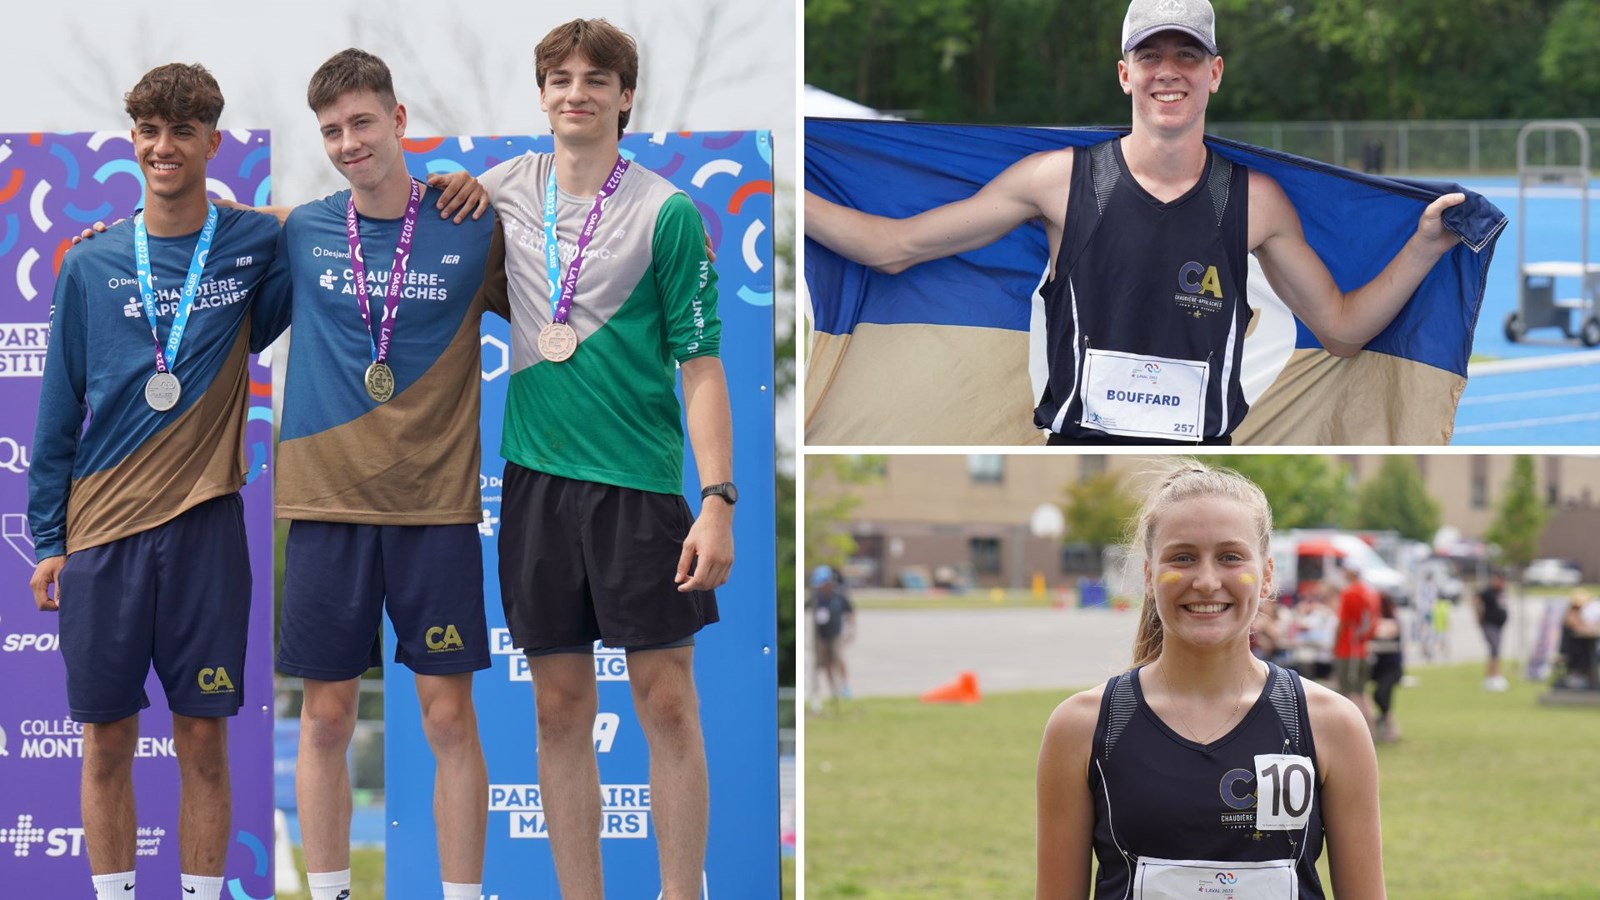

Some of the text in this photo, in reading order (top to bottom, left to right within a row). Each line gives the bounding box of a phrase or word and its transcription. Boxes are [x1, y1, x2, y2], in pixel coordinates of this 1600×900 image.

[607, 165, 625, 189] 2022
[201, 213, 217, 242] LAVAL
[401, 218, 415, 244] 2022
[584, 213, 598, 237] OASIS
[137, 240, 149, 265] 2022
[236, 256, 253, 268] IGA
[441, 254, 461, 265] IGA
[185, 272, 199, 297] OASIS
[356, 271, 366, 296] OASIS
[390, 272, 401, 297] OASIS
[561, 266, 579, 301] LAVAL
[1178, 261, 1223, 299] CA
[167, 324, 183, 352] 2022
[378, 327, 391, 361] LAVAL
[1106, 389, 1181, 407] BOUFFARD
[1173, 423, 1195, 433] 257
[425, 624, 464, 650] CA
[198, 666, 234, 691] CA
[1219, 768, 1258, 810] C
[1261, 763, 1312, 818] 10
[153, 826, 165, 836] de
